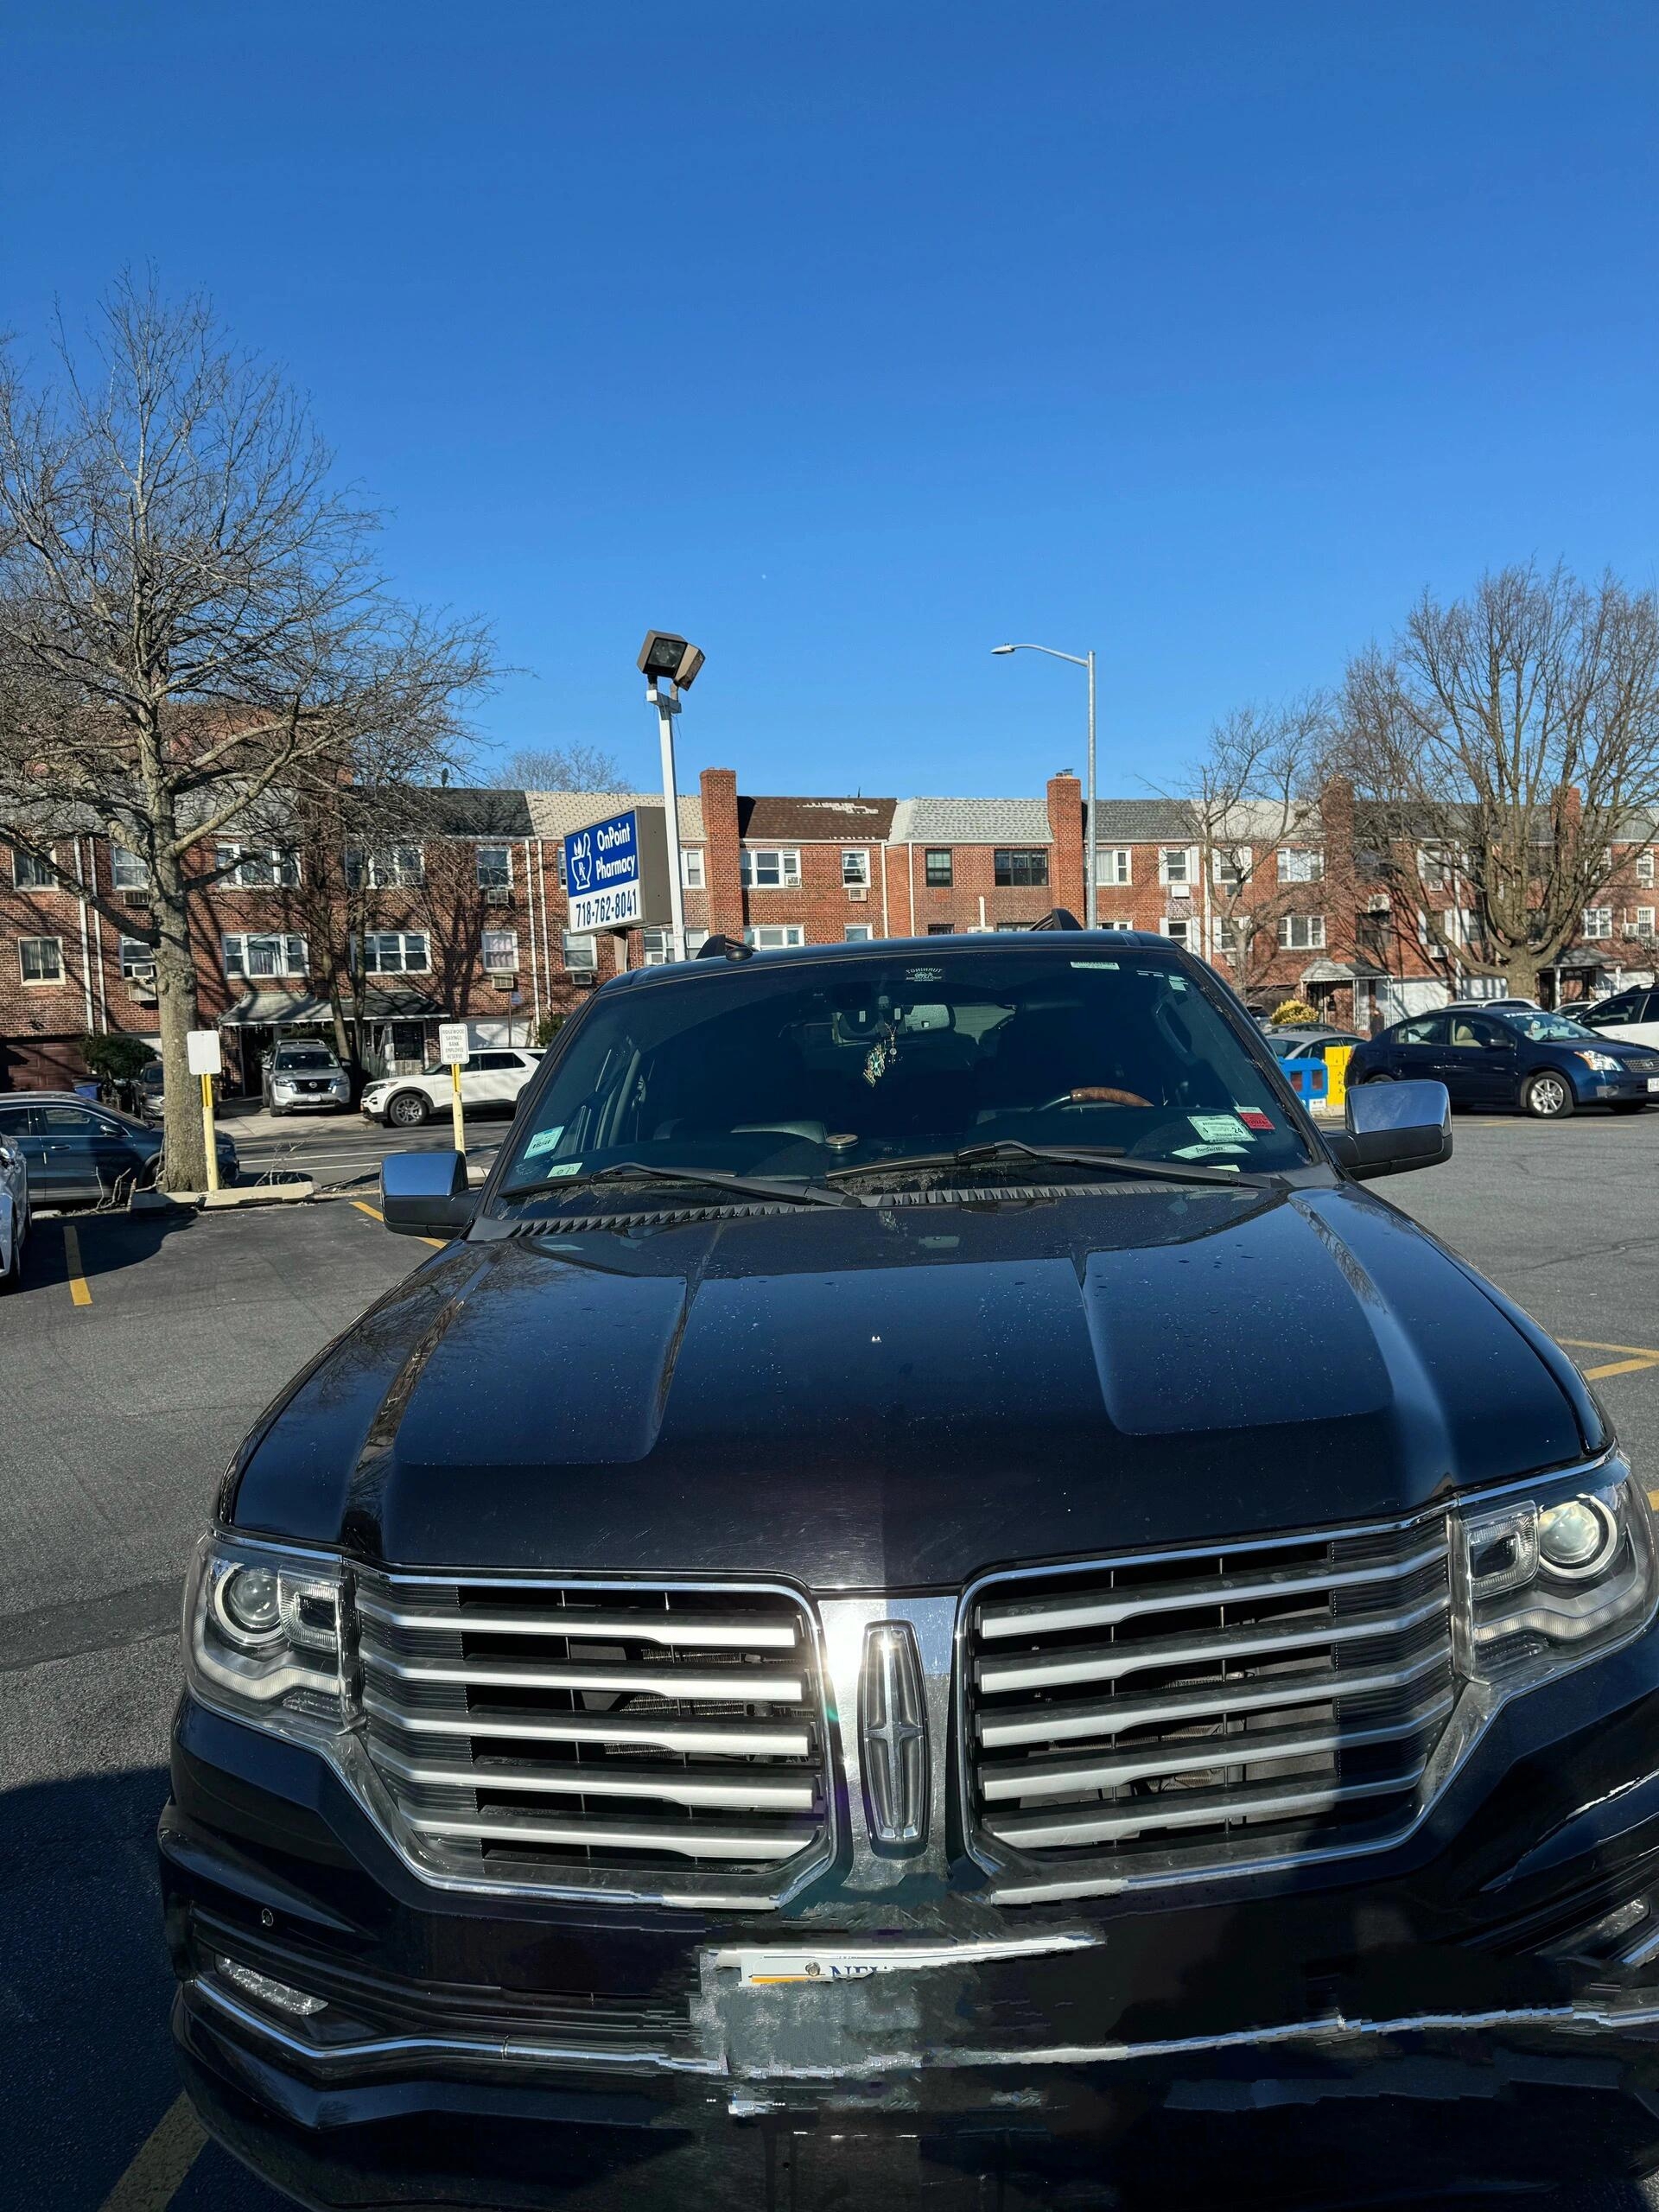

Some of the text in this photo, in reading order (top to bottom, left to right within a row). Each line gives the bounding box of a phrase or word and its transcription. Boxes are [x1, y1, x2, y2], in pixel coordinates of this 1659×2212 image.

[597, 822, 631, 852] OnPoint
[595, 855, 635, 880] Pharmacy
[575, 888, 637, 928] 718-762-8041
